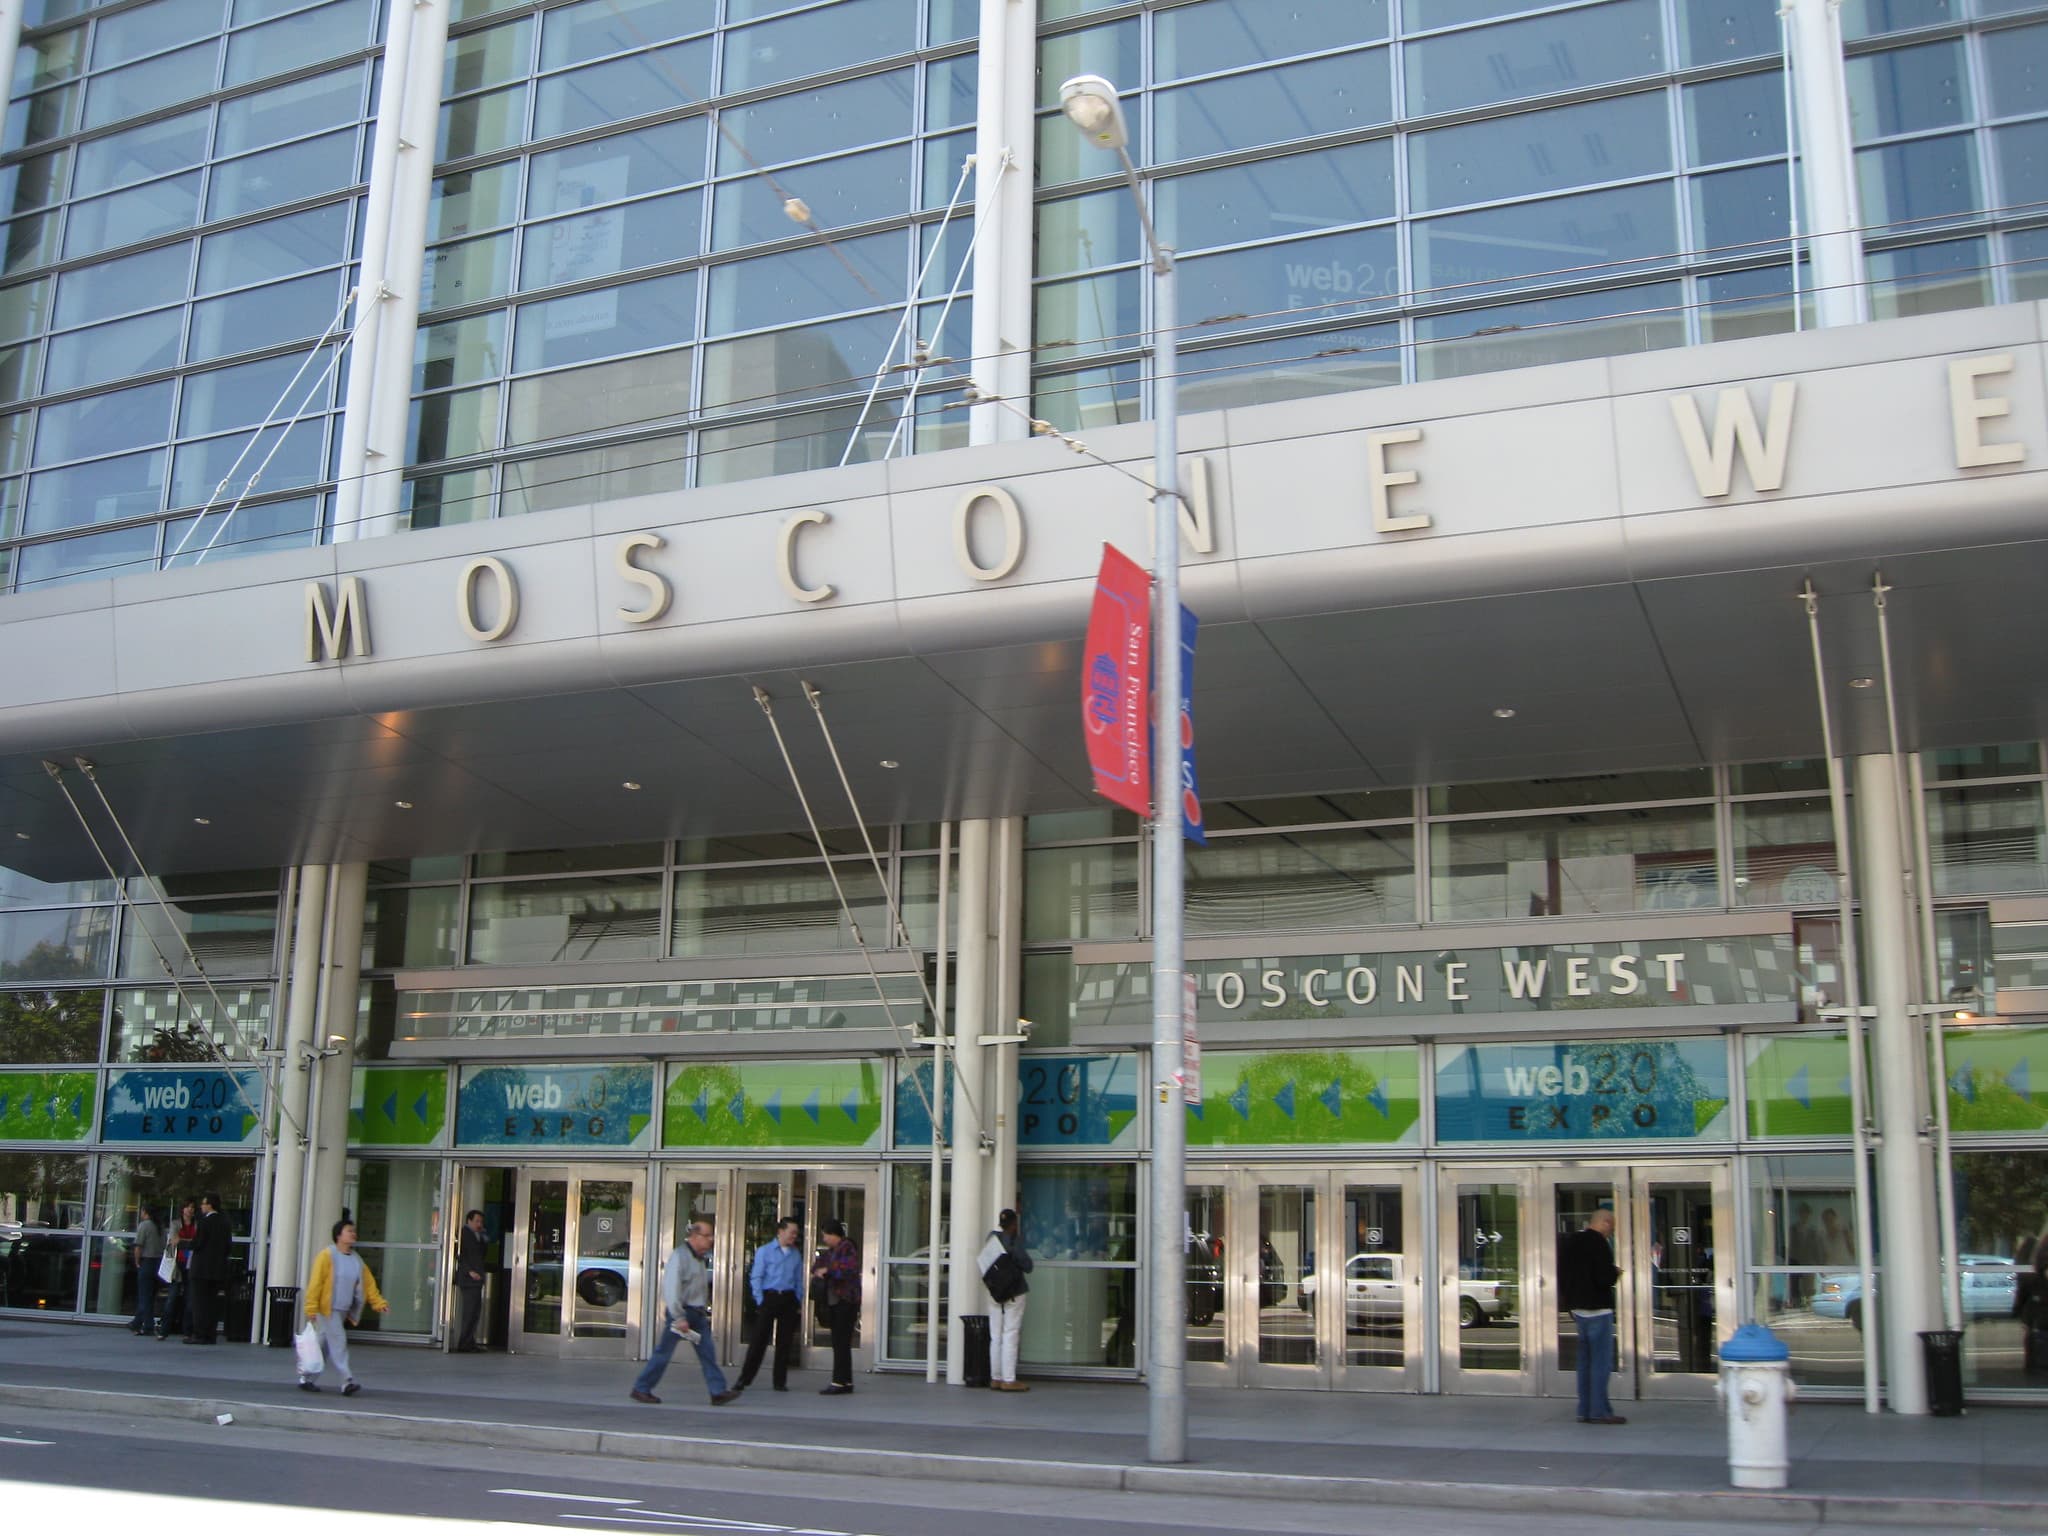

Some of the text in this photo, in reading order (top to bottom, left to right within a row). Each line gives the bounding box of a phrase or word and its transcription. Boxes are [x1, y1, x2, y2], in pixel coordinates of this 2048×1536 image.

[303, 353, 2028, 664] MOSCONE WE
[1216, 962, 1470, 1009] OSCONE
[1504, 952, 1685, 999] WEST
[142, 1115, 224, 1135] EXPO
[505, 1115, 606, 1138] EXPO
[1023, 1113, 1079, 1137] PO
[1508, 1103, 1658, 1131] EXPO
